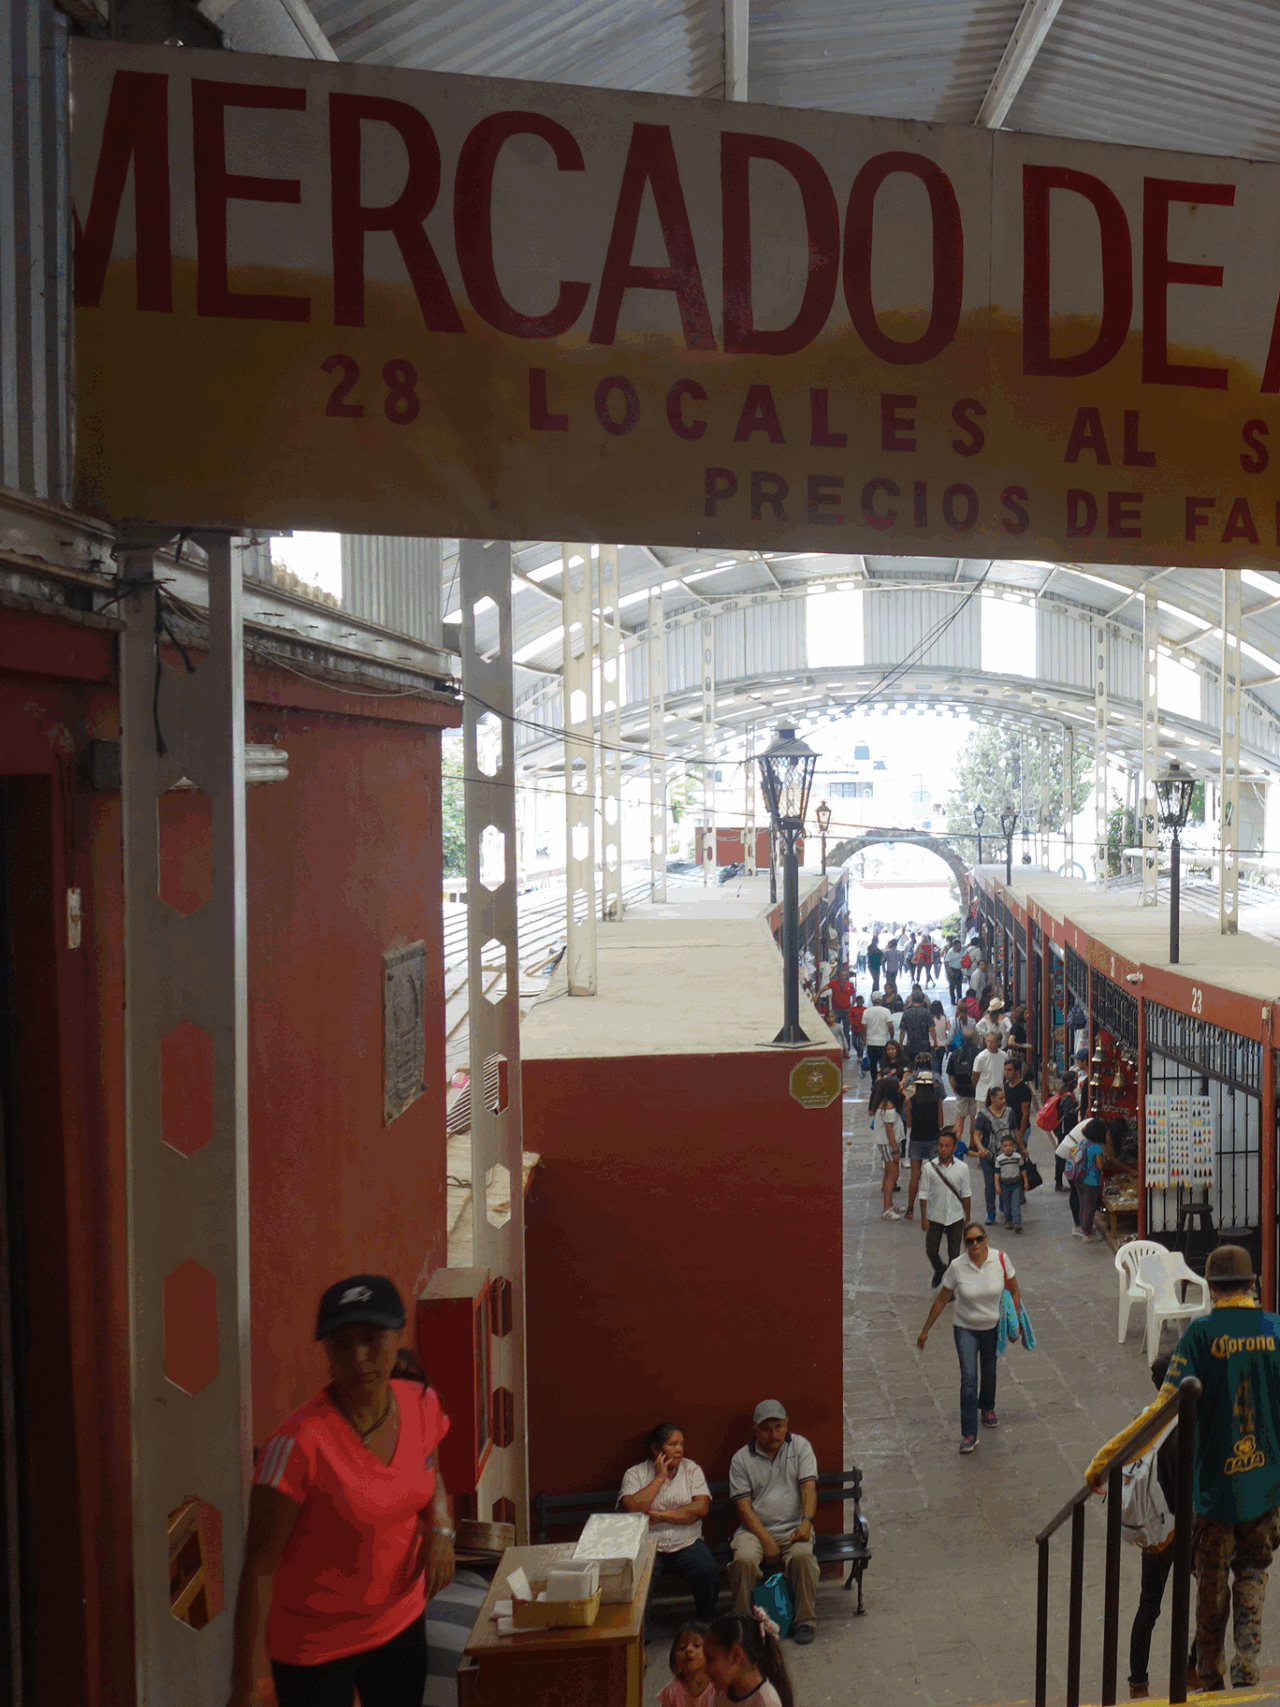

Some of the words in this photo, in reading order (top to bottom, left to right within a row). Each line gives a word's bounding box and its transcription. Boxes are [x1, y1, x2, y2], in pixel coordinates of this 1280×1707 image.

[1021, 163, 1236, 391] DE
[319, 354, 421, 425] 28
[528, 367, 986, 457] LOCALES
[1063, 406, 1157, 468] AL
[704, 467, 1030, 536] PRECIOS
[1066, 488, 1145, 539] DE
[1191, 987, 1203, 1015] 23
[1211, 1334, 1276, 1359] Corona
